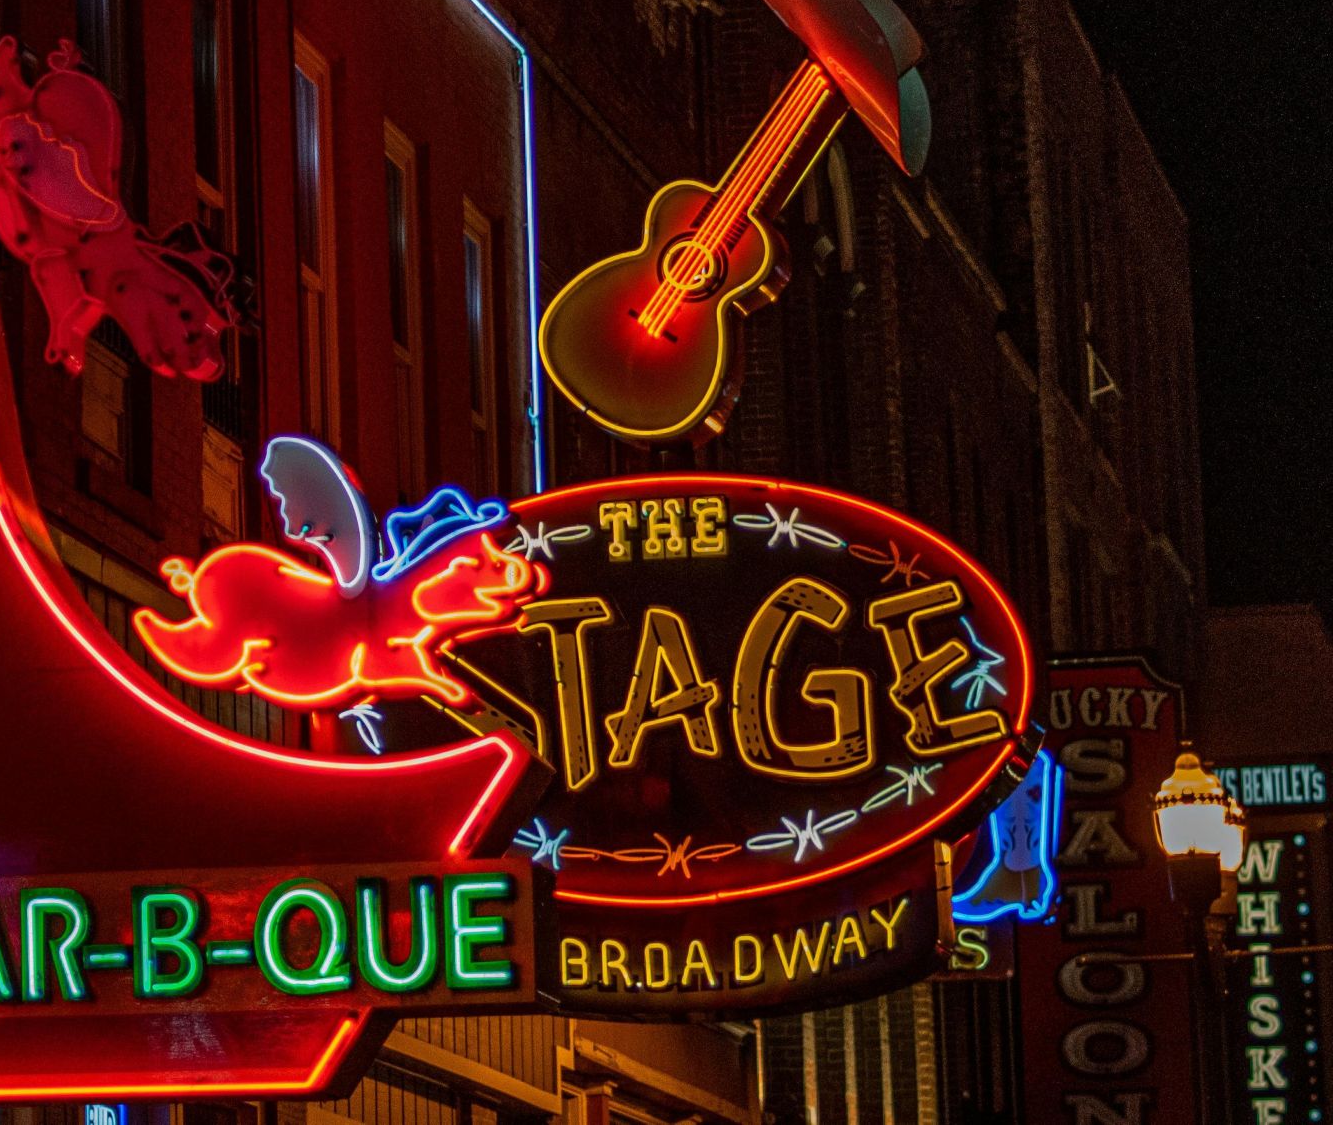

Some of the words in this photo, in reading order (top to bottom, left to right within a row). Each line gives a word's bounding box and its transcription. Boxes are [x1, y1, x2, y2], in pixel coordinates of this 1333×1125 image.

[598, 496, 727, 560] THE
[1049, 685, 1169, 731] UCKY
[560, 896, 912, 990] BROADWAY
